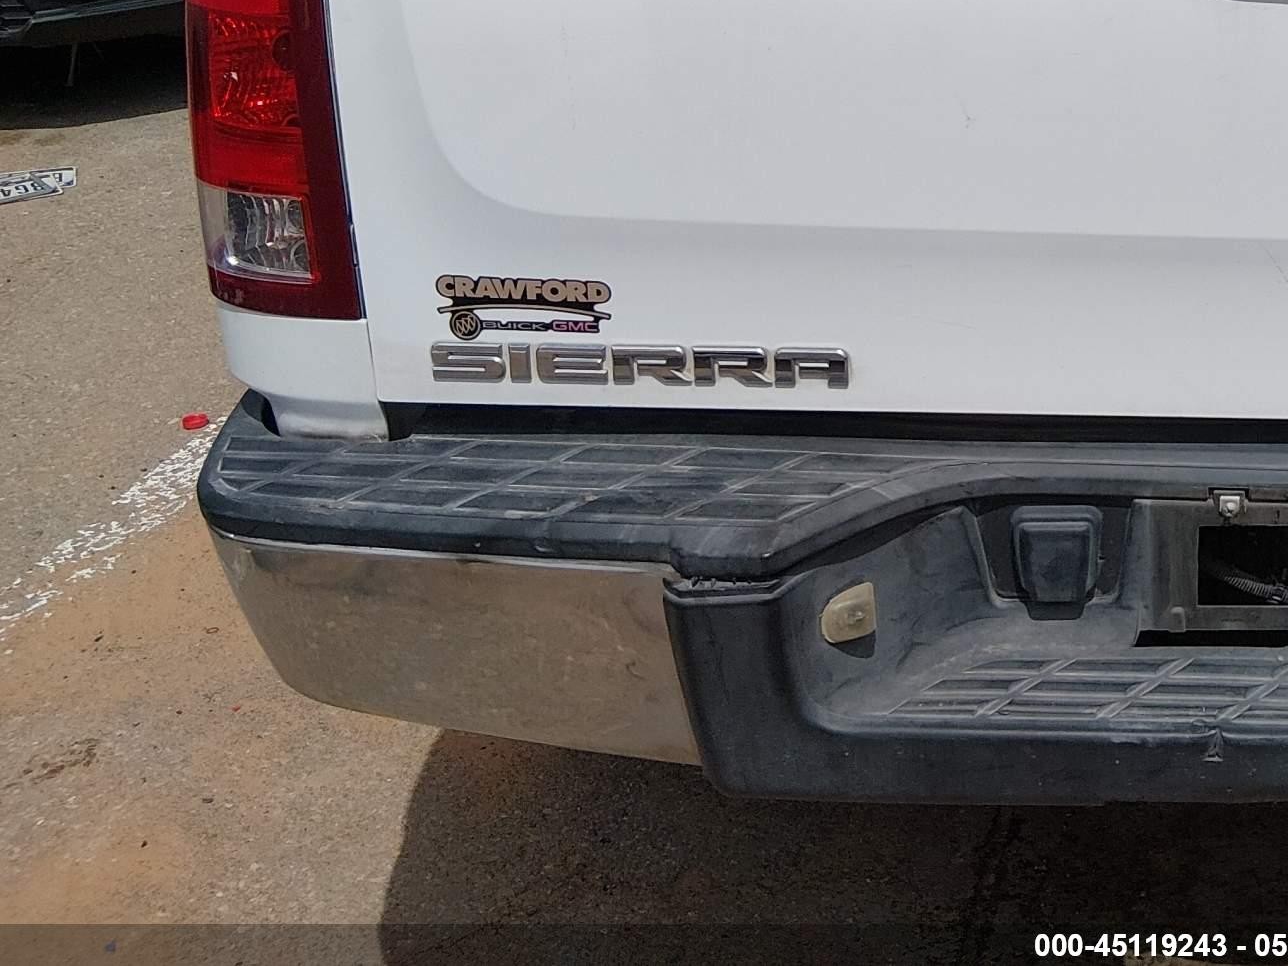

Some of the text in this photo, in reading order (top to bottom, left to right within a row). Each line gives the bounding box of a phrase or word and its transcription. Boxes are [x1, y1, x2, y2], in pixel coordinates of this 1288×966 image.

[436, 274, 611, 304] CRAWFORD
[482, 320, 599, 332] BUICK GMC
[431, 343, 849, 388] SIERRA
